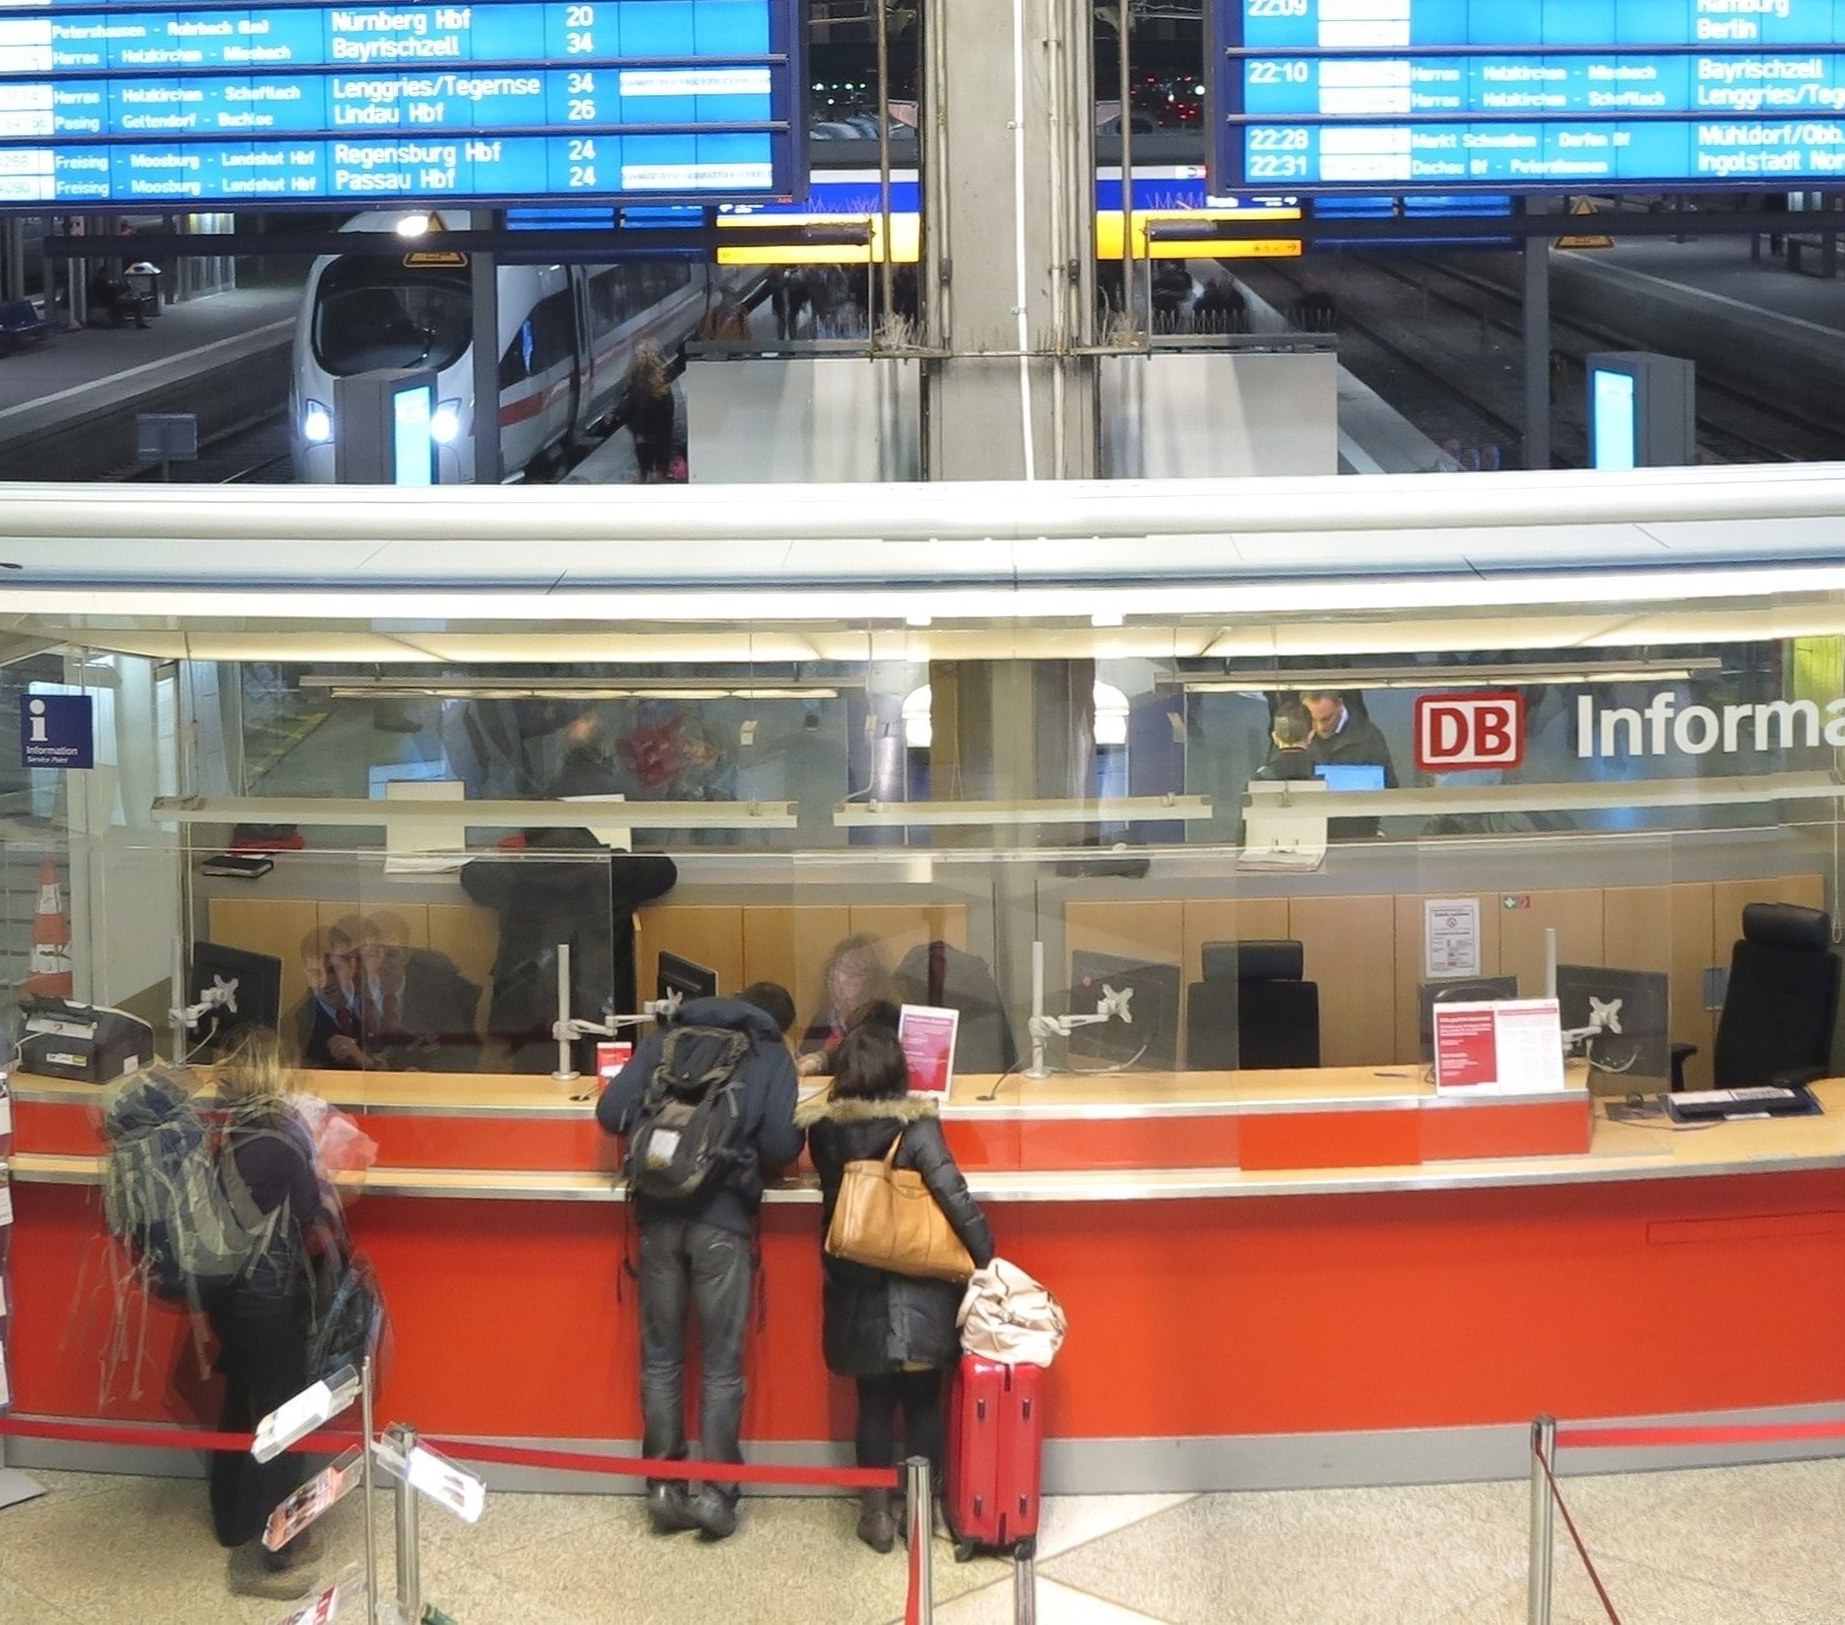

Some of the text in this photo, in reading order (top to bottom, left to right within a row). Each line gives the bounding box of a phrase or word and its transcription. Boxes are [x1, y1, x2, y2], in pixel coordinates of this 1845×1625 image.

[331, 8, 426, 34] Nürnberg
[436, 8, 472, 30] Hbf
[566, 6, 594, 27] 20
[1697, 19, 1757, 40] Berlin
[332, 36, 459, 63] Bayrischzell
[567, 33, 594, 55] 34
[1249, 62, 1308, 84] 22:10
[1698, 58, 1824, 84] Bayrischzell
[333, 73, 595, 103] Lenggries/Tegernse 34
[334, 104, 399, 126] Lindau
[409, 101, 444, 123] Hbf
[568, 100, 596, 121] 26
[1249, 129, 1308, 151] 22:28
[1698, 124, 1845, 146] Mühldorf/Obb.
[56, 155, 108, 173] Freising
[130, 153, 200, 171] Moosburg
[221, 150, 285, 168] Landshut
[290, 149, 316, 167] Hbf
[335, 143, 456, 168] Regensburg
[465, 141, 501, 163] Hbf
[568, 140, 596, 162] 24
[1250, 155, 1307, 177] 22:31
[1698, 151, 1802, 176] Ingolstadt
[57, 167, 596, 199] Freising Moosburg Landshut Hbf Passau Hbf 24
[1423, 700, 1516, 763] DB
[26, 745, 79, 756] Information
[51, 756, 69, 764] Point
